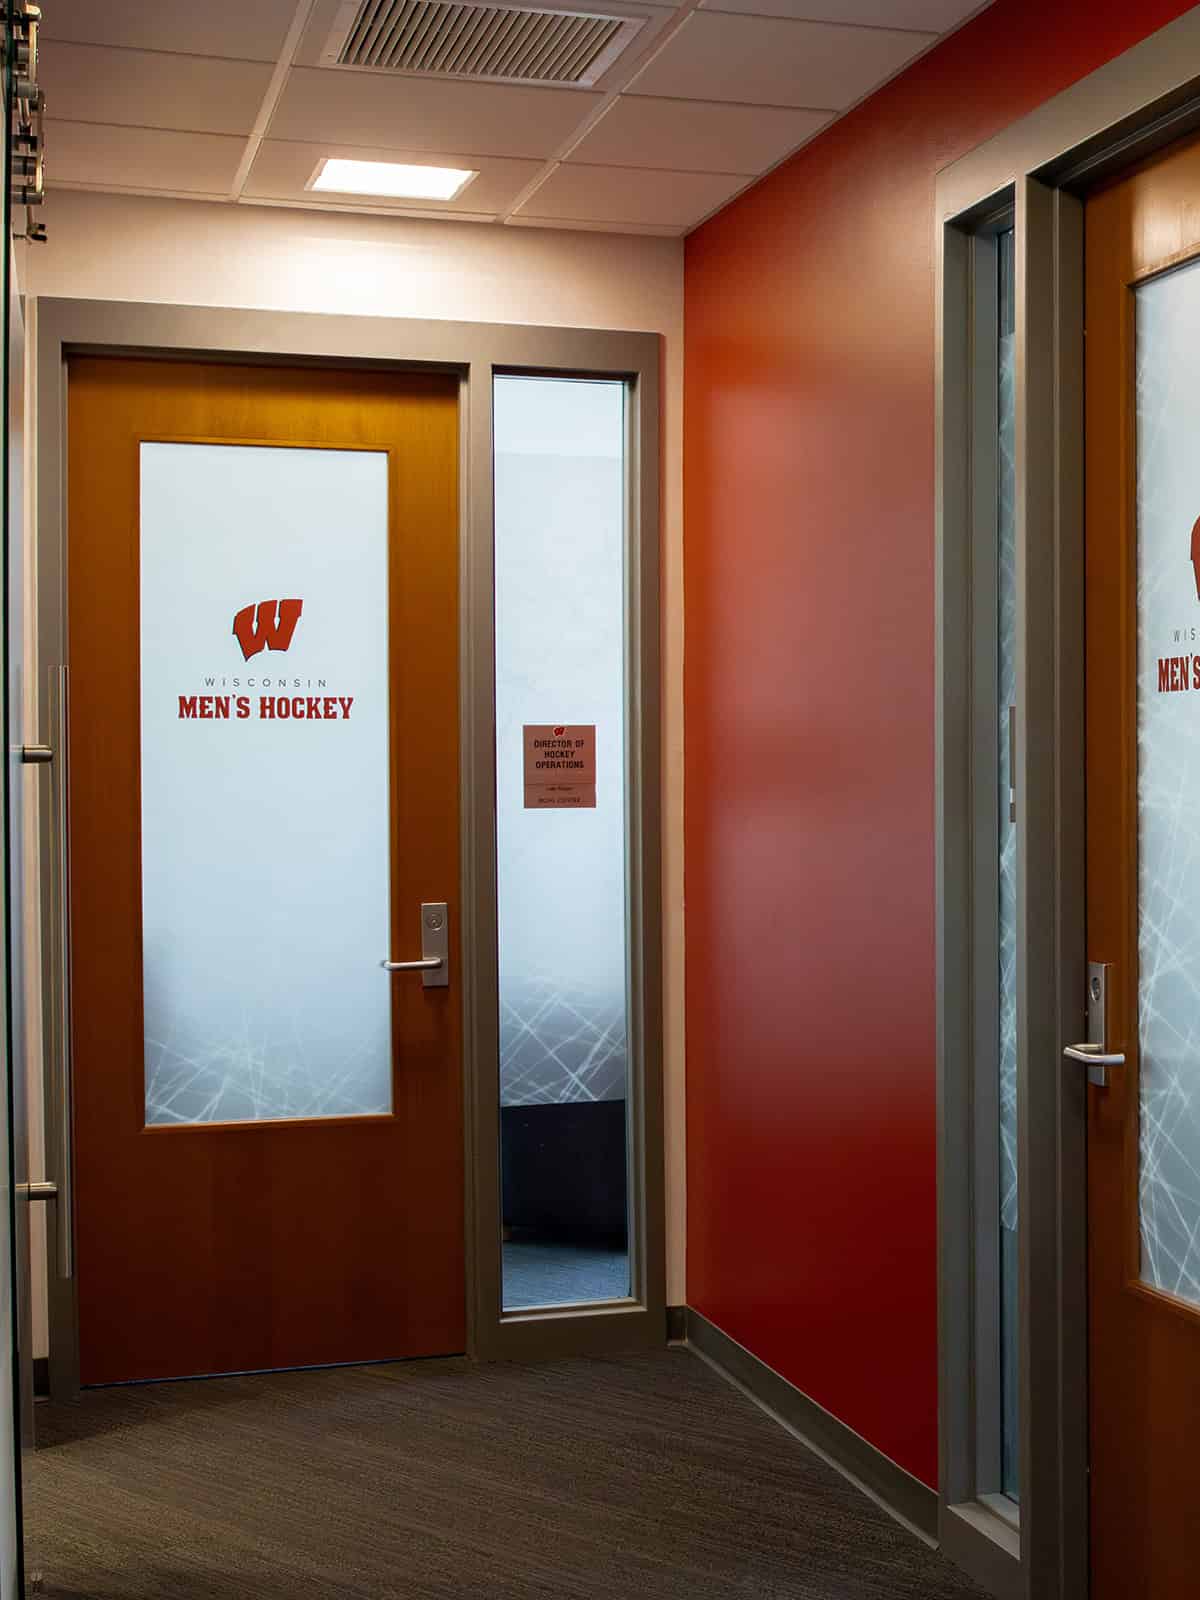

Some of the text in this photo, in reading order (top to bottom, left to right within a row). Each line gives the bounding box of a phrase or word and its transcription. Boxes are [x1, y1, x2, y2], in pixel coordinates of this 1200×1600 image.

[204, 678, 327, 688] WISCONSIN
[178, 694, 354, 719] MEN'S HOCKEY
[534, 739, 585, 749] DIRECTOR OF
[544, 750, 576, 759] HOCKEY
[535, 760, 584, 769] OPERATIONS
